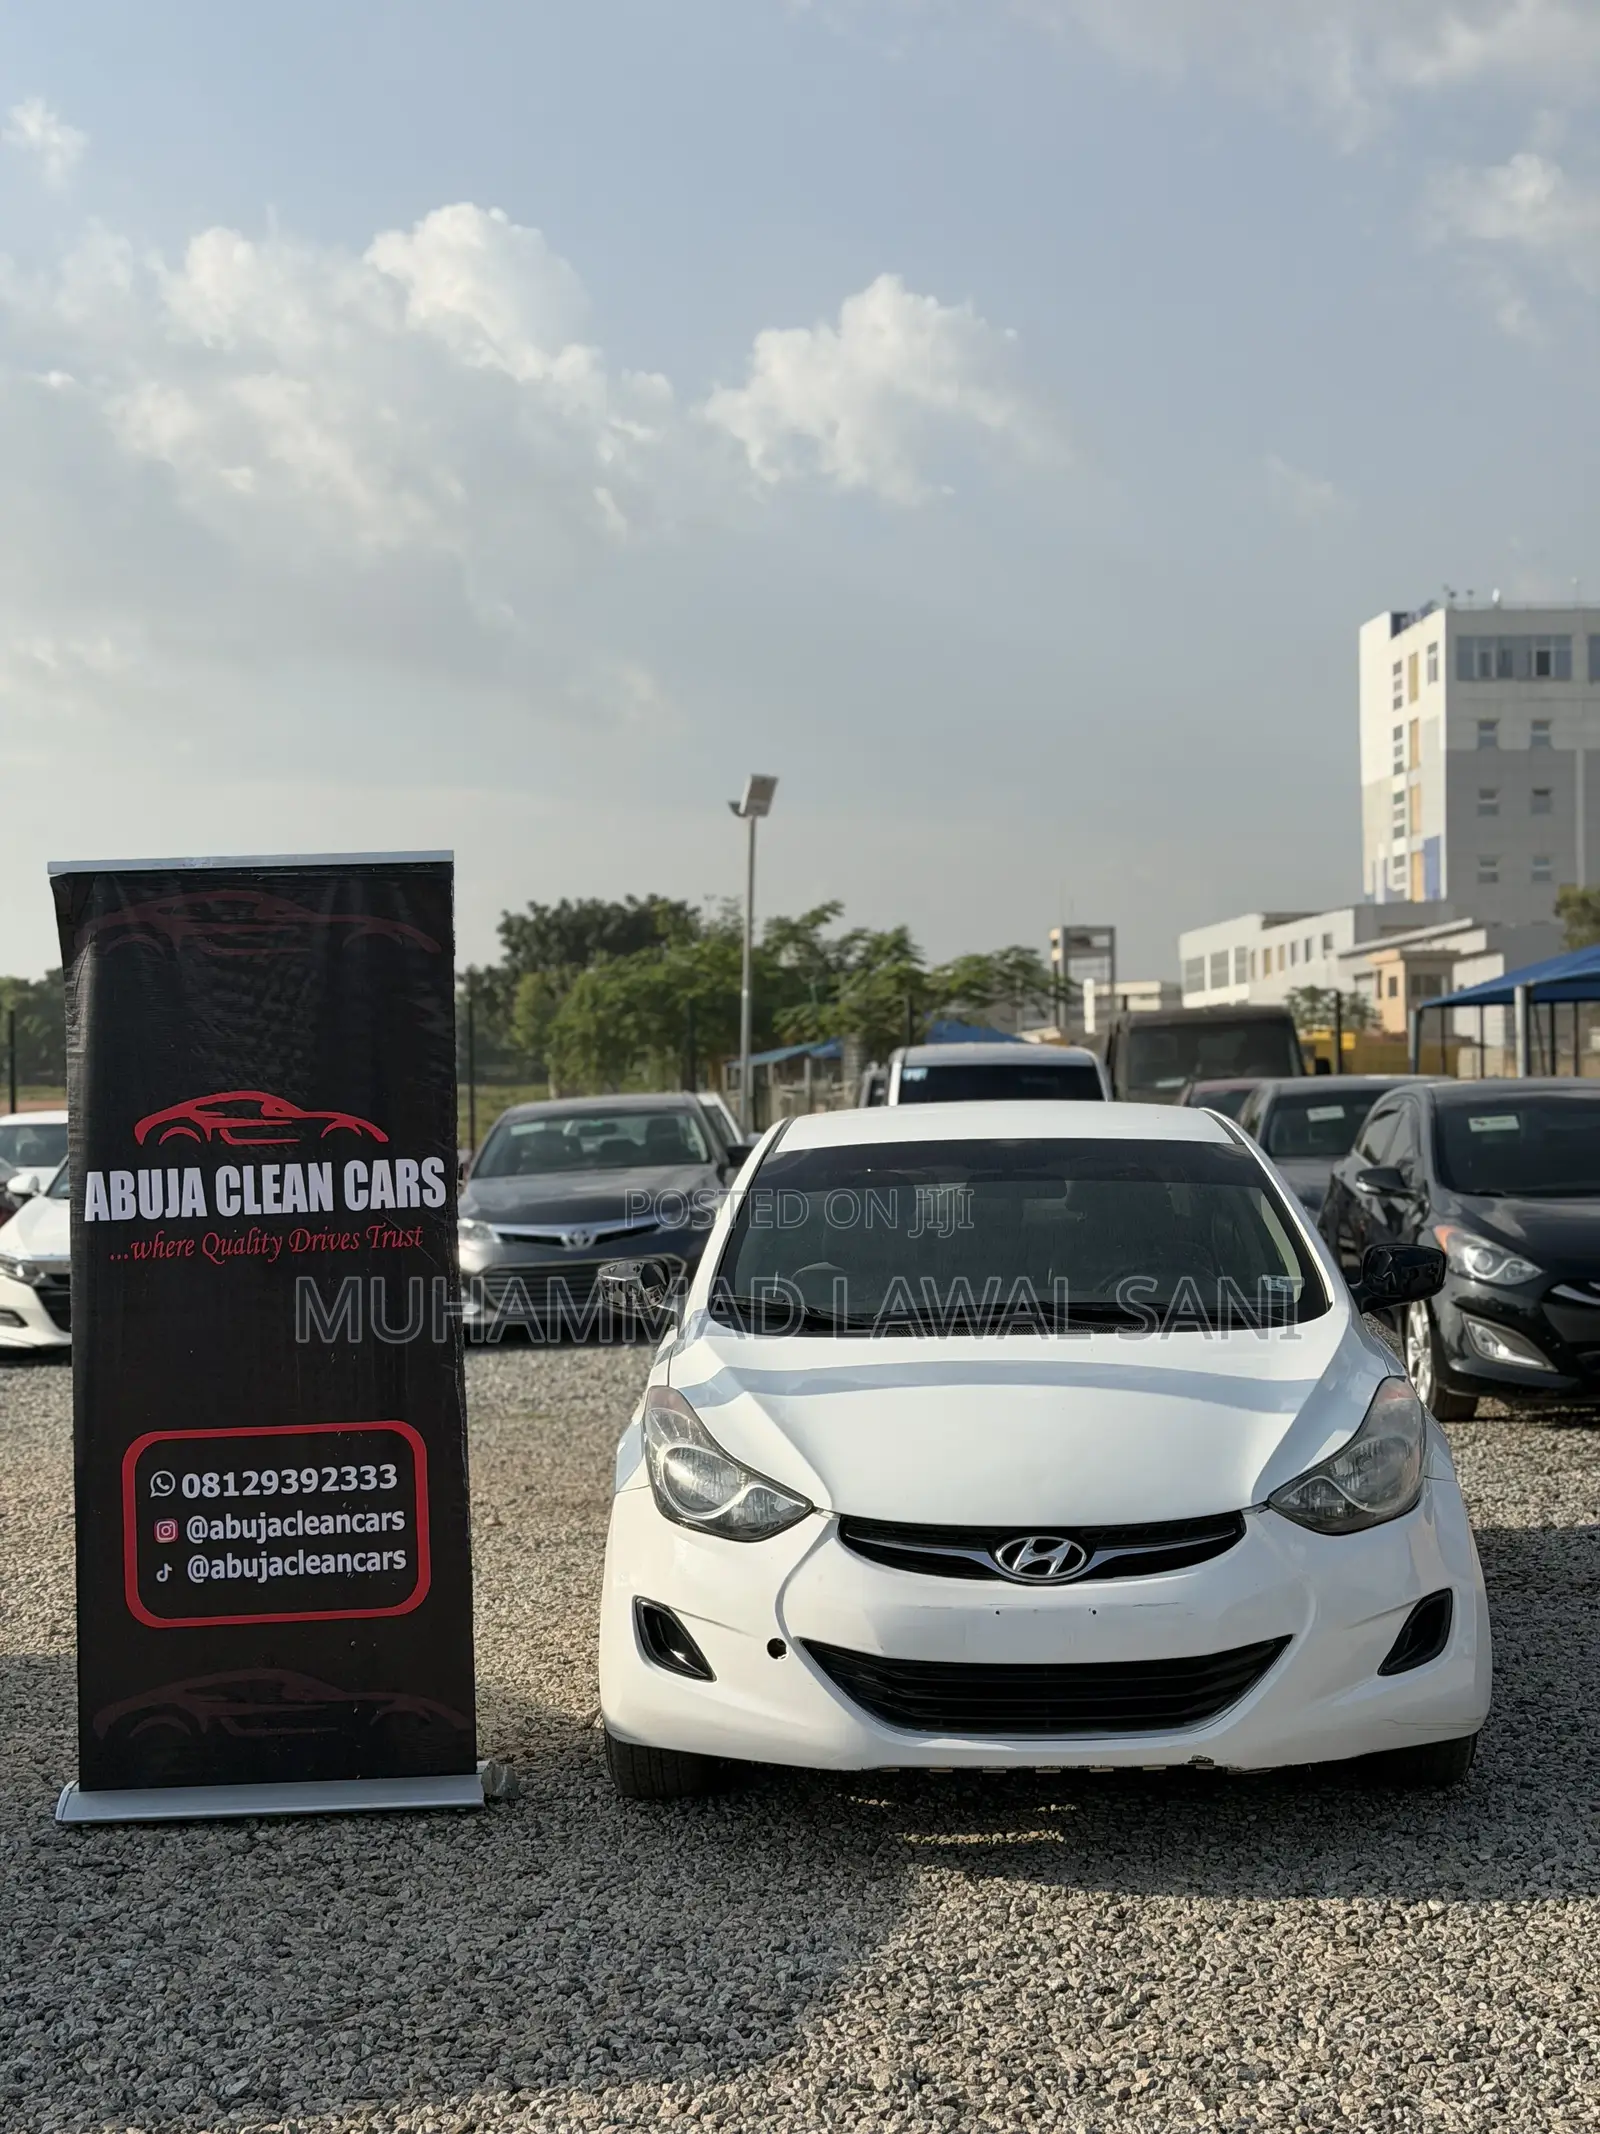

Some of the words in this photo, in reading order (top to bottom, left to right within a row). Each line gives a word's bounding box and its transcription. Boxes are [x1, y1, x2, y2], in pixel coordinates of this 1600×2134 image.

[84, 1167, 207, 1222] ABUJA
[215, 1162, 335, 1217] CLEAN
[343, 1156, 447, 1211] CARS
[201, 1226, 283, 1264] Quality
[288, 1227, 360, 1254] Drives
[364, 1224, 423, 1249] Trust
[181, 1463, 398, 1499] 08129392333
[186, 1510, 406, 1544] @abujacleancars
[187, 1549, 407, 1583] @abujacleancars
